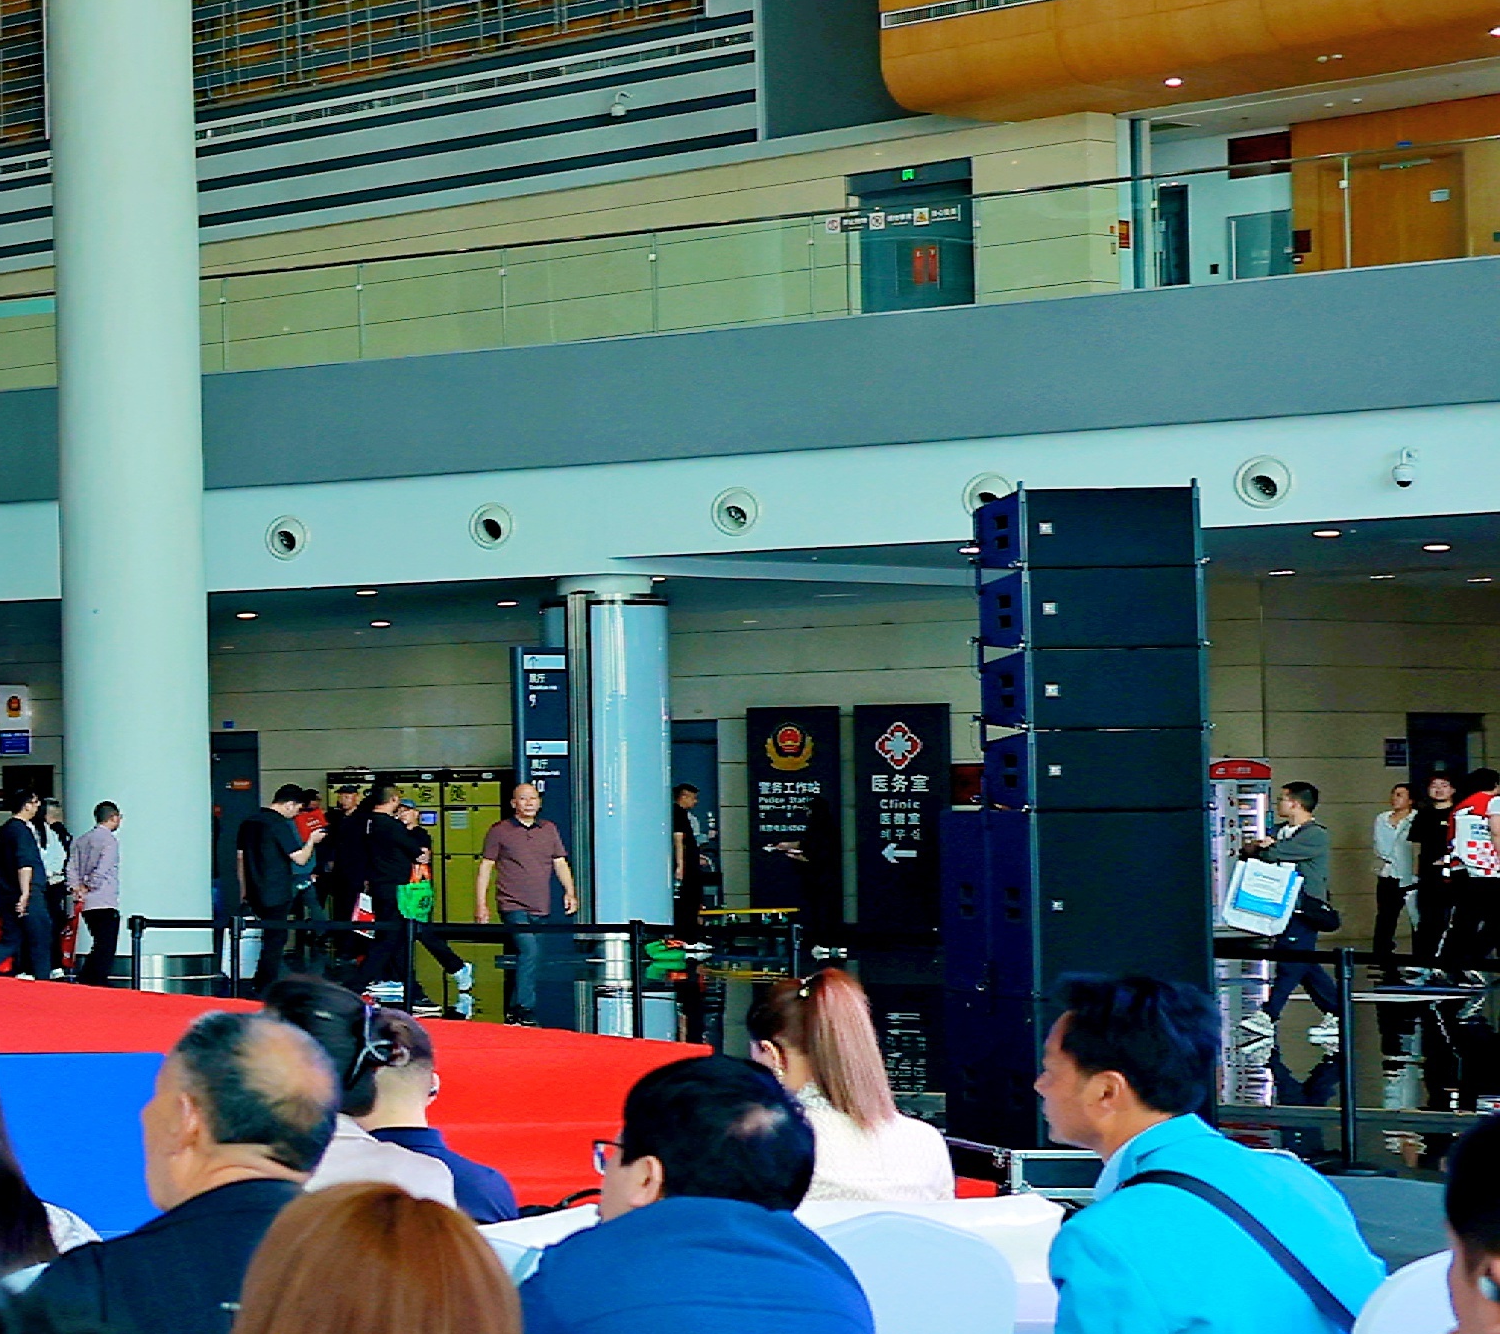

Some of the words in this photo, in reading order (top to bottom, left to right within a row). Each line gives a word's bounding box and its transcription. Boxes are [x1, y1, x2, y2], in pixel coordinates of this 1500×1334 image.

[871, 773, 930, 793] 医务室
[879, 798, 921, 809] Clinic
